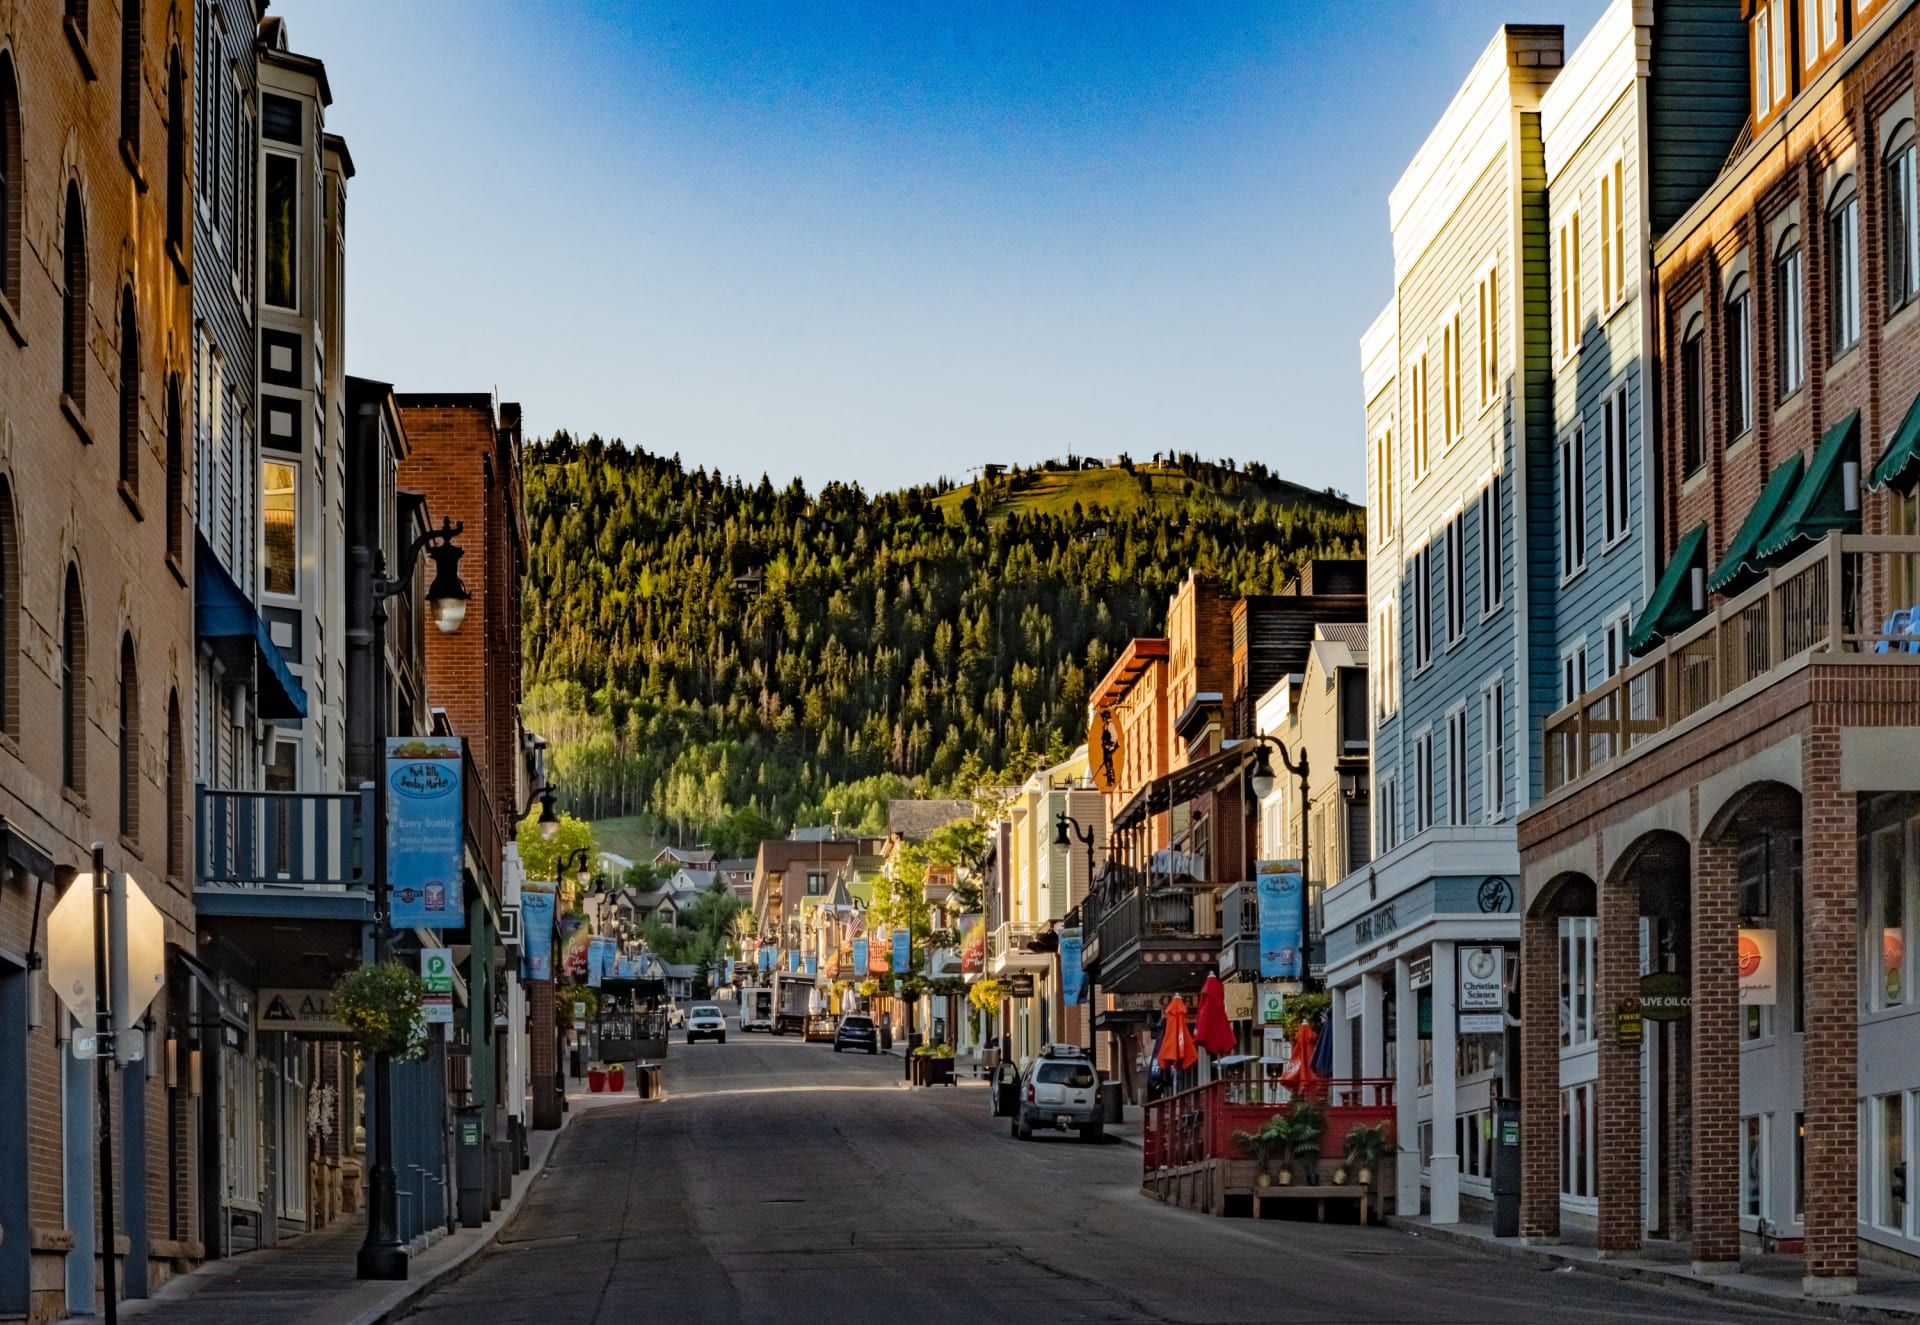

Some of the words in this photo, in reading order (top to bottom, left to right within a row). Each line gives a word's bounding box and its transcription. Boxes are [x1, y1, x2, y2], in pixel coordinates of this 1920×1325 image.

[409, 765, 424, 777] Park
[401, 776, 424, 792] Sunday
[425, 778, 448, 790] Market
[399, 819, 422, 829] Every
[424, 817, 455, 829] Sunday
[432, 959, 441, 972] P
[1463, 981, 1500, 991] Christian
[1467, 990, 1496, 999] Science
[1640, 996, 1662, 1006] LIVE
[1663, 996, 1681, 1006] OIL
